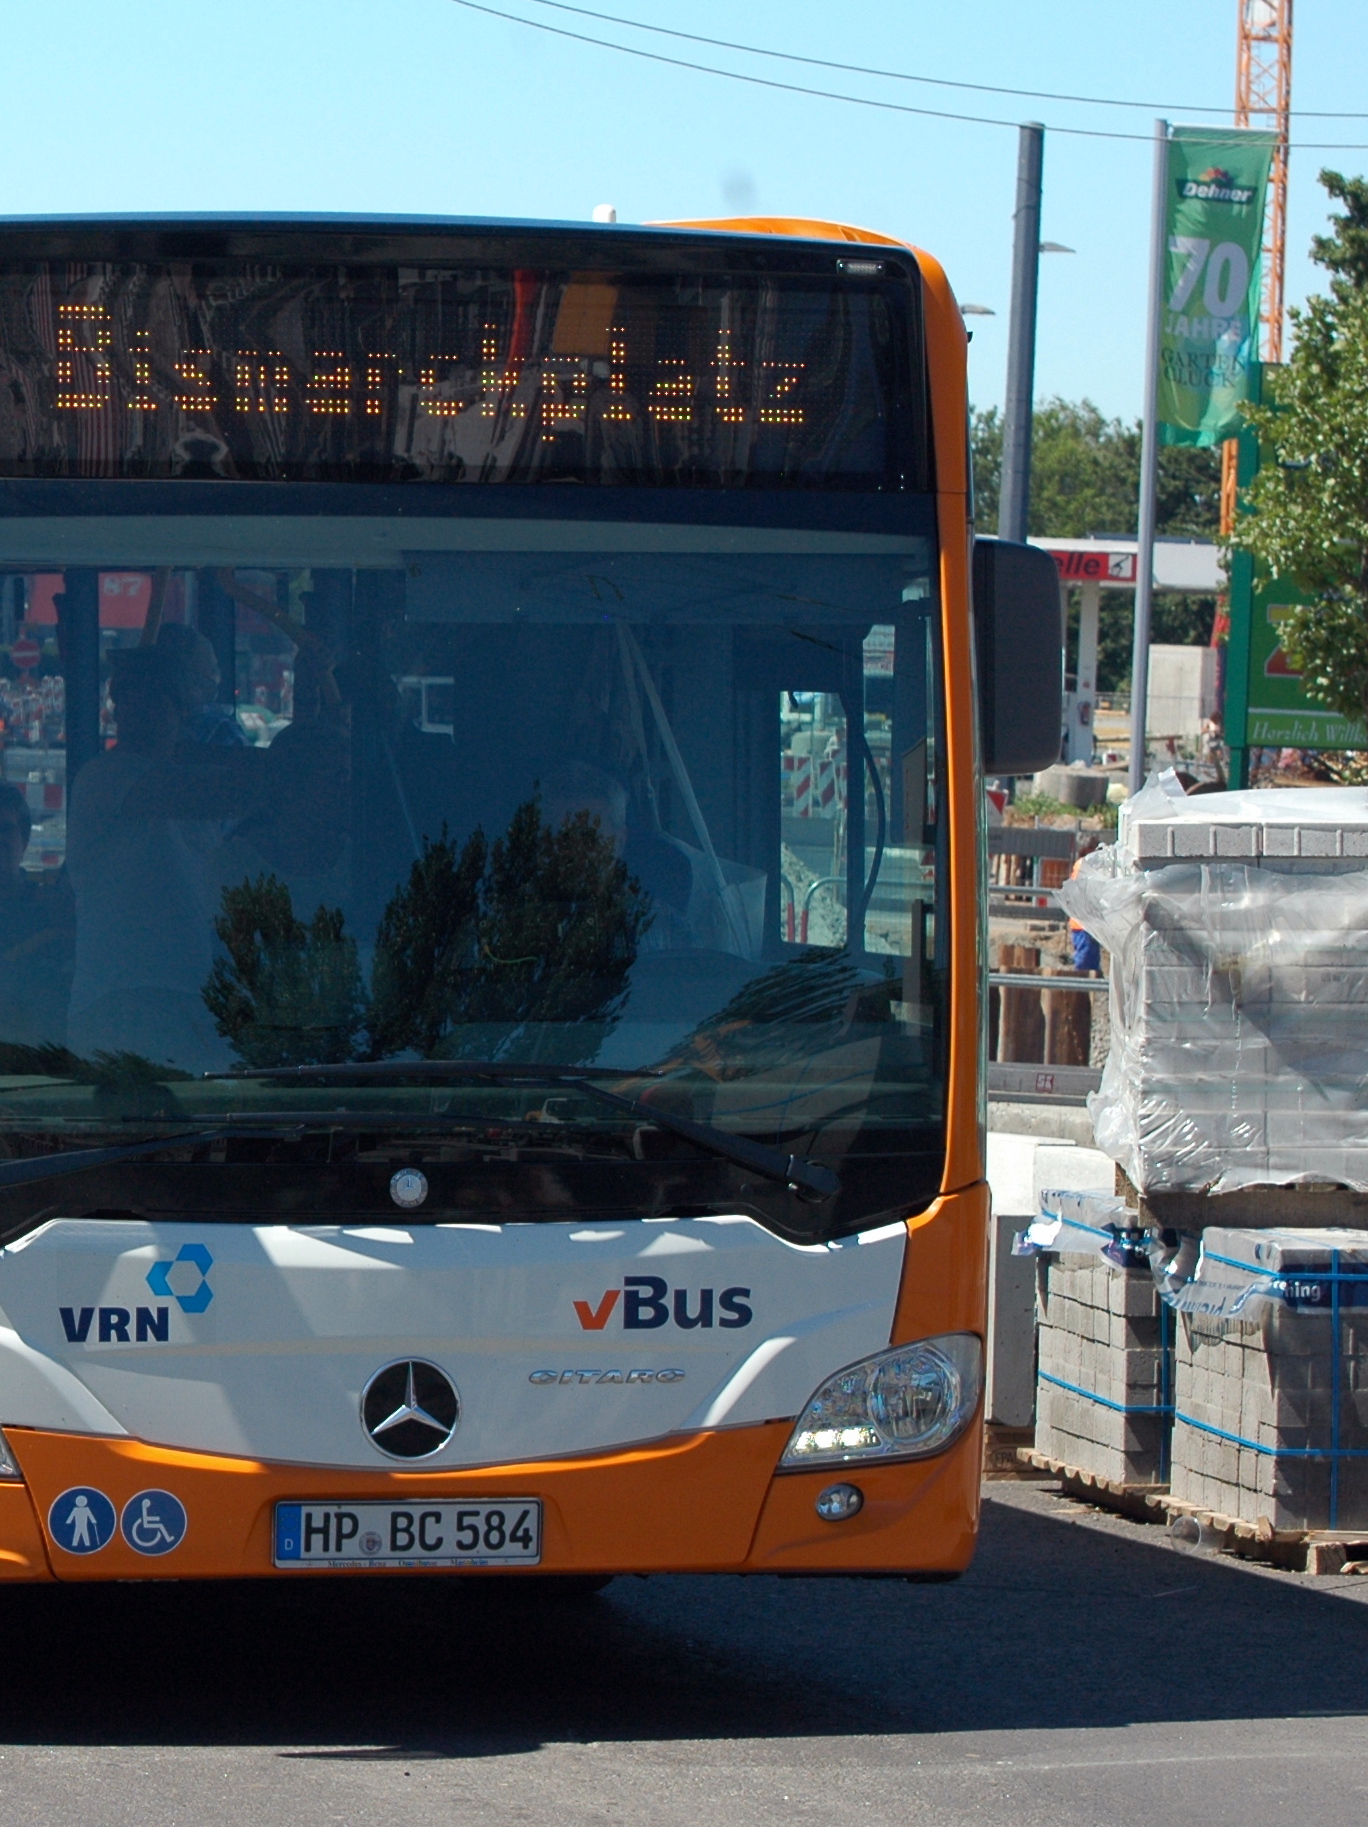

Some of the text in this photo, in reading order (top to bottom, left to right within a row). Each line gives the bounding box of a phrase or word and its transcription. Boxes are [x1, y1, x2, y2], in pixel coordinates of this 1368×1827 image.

[1182, 181, 1254, 203] Dehner
[1168, 235, 1249, 318] 70
[1164, 312, 1242, 341] JAHRE
[57, 304, 806, 442] Bismarckplatz
[1253, 721, 1320, 742] Herzlich
[573, 1275, 754, 1330] vBus
[58, 1306, 170, 1343] VRN
[528, 1368, 686, 1385] CITARO
[284, 1538, 294, 1550] D
[304, 1509, 533, 1553] HP BC 584
